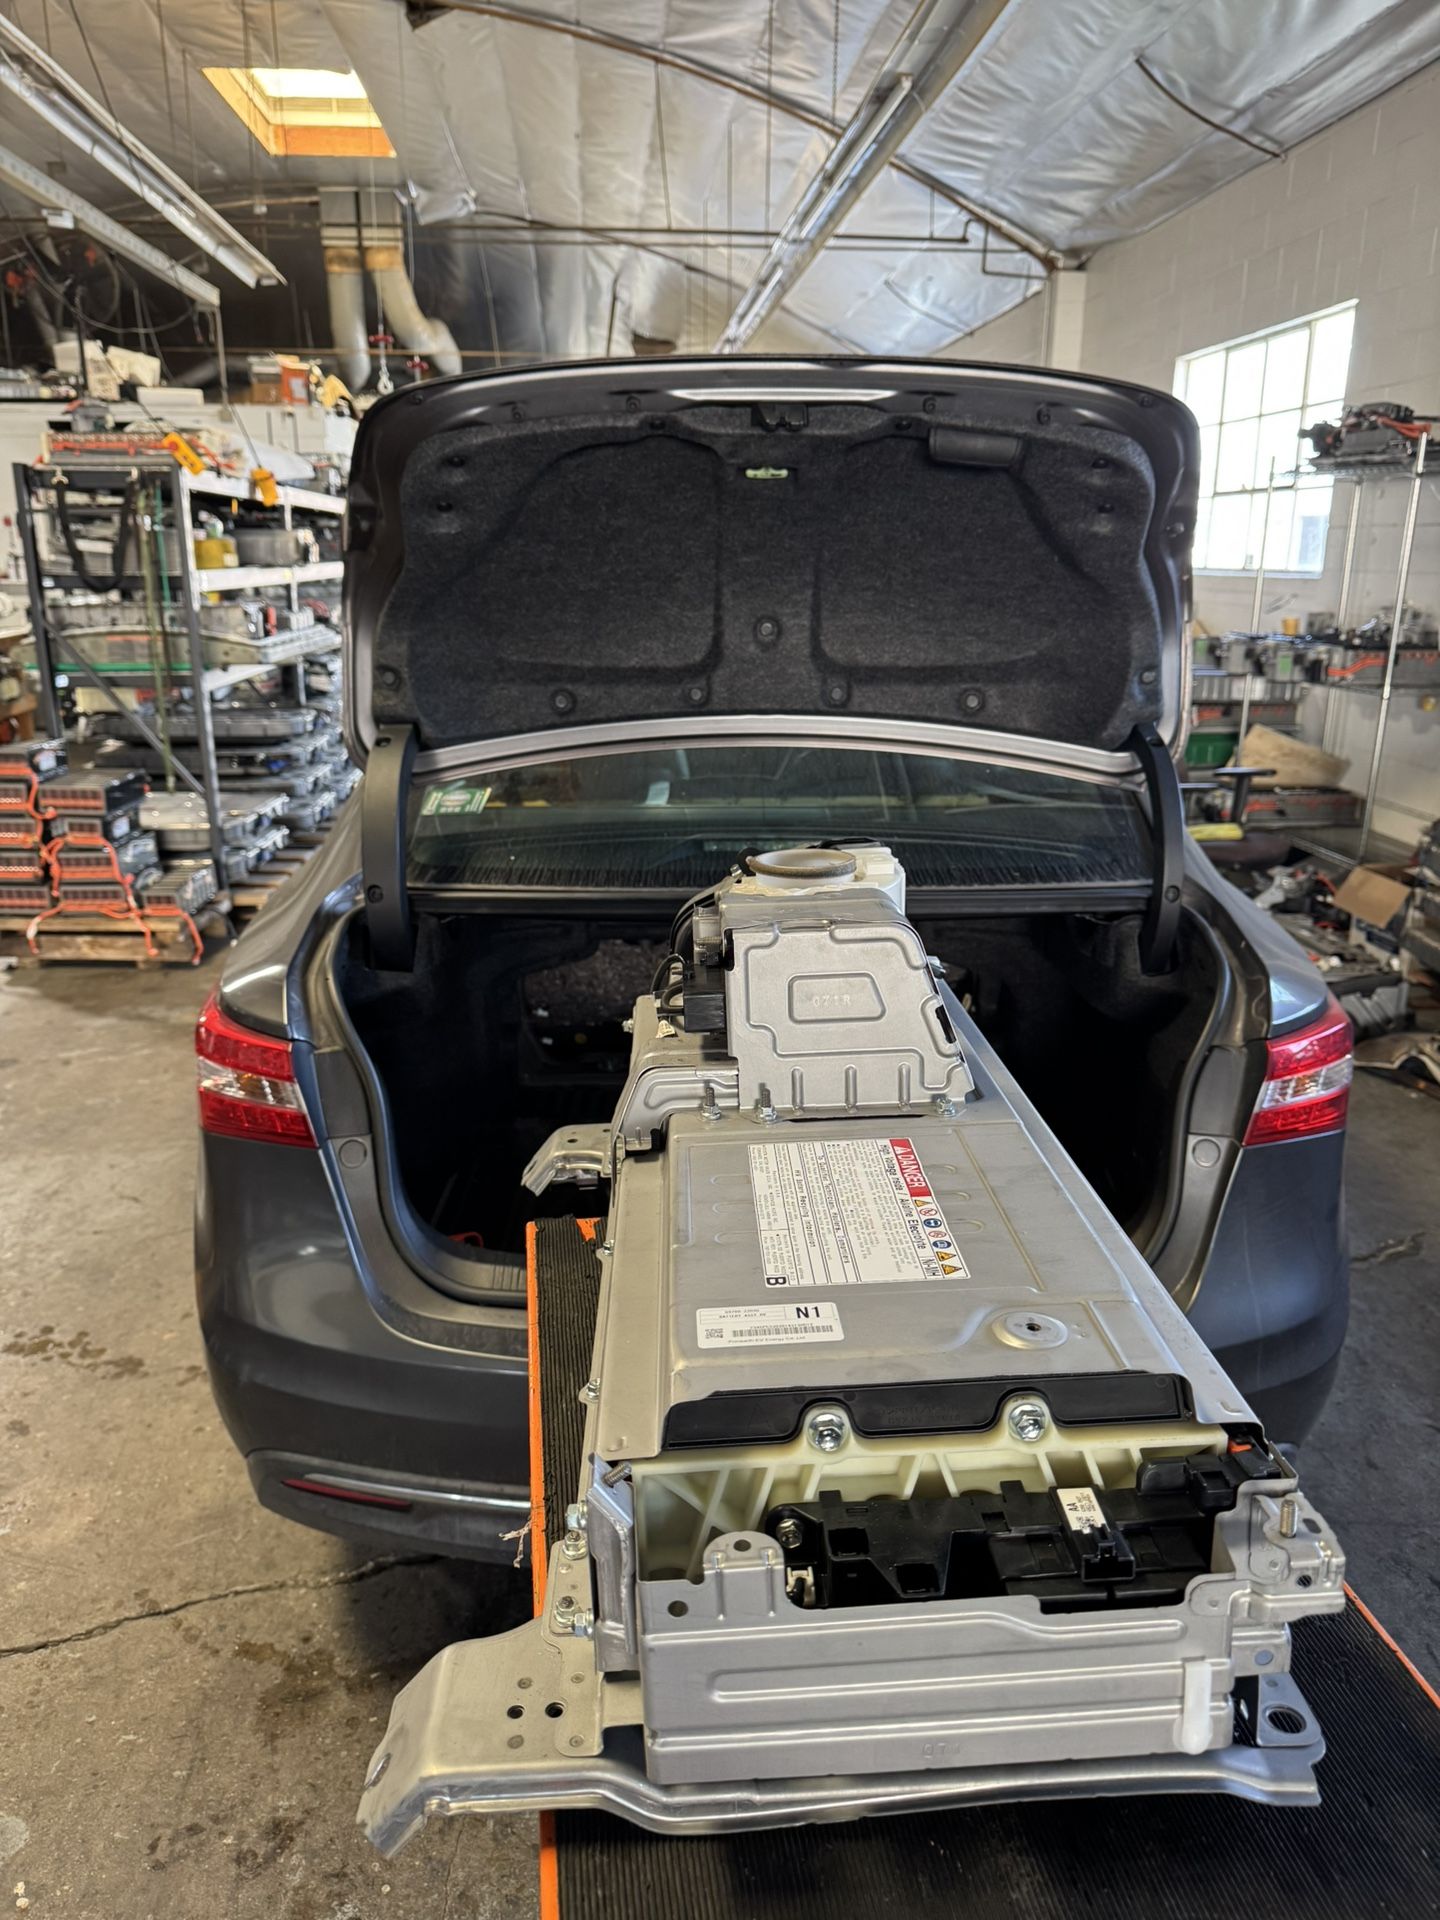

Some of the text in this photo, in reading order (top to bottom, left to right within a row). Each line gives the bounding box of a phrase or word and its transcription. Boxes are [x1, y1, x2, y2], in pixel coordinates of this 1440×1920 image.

[877, 1144, 890, 1154] High
[881, 1156, 899, 1175] Voltage
[896, 1155, 924, 1187] DANGER
[898, 1197, 915, 1217] Alkaline
[905, 1219, 928, 1249] Electrolyte
[765, 1275, 787, 1286] B
[796, 1306, 820, 1319] N1
